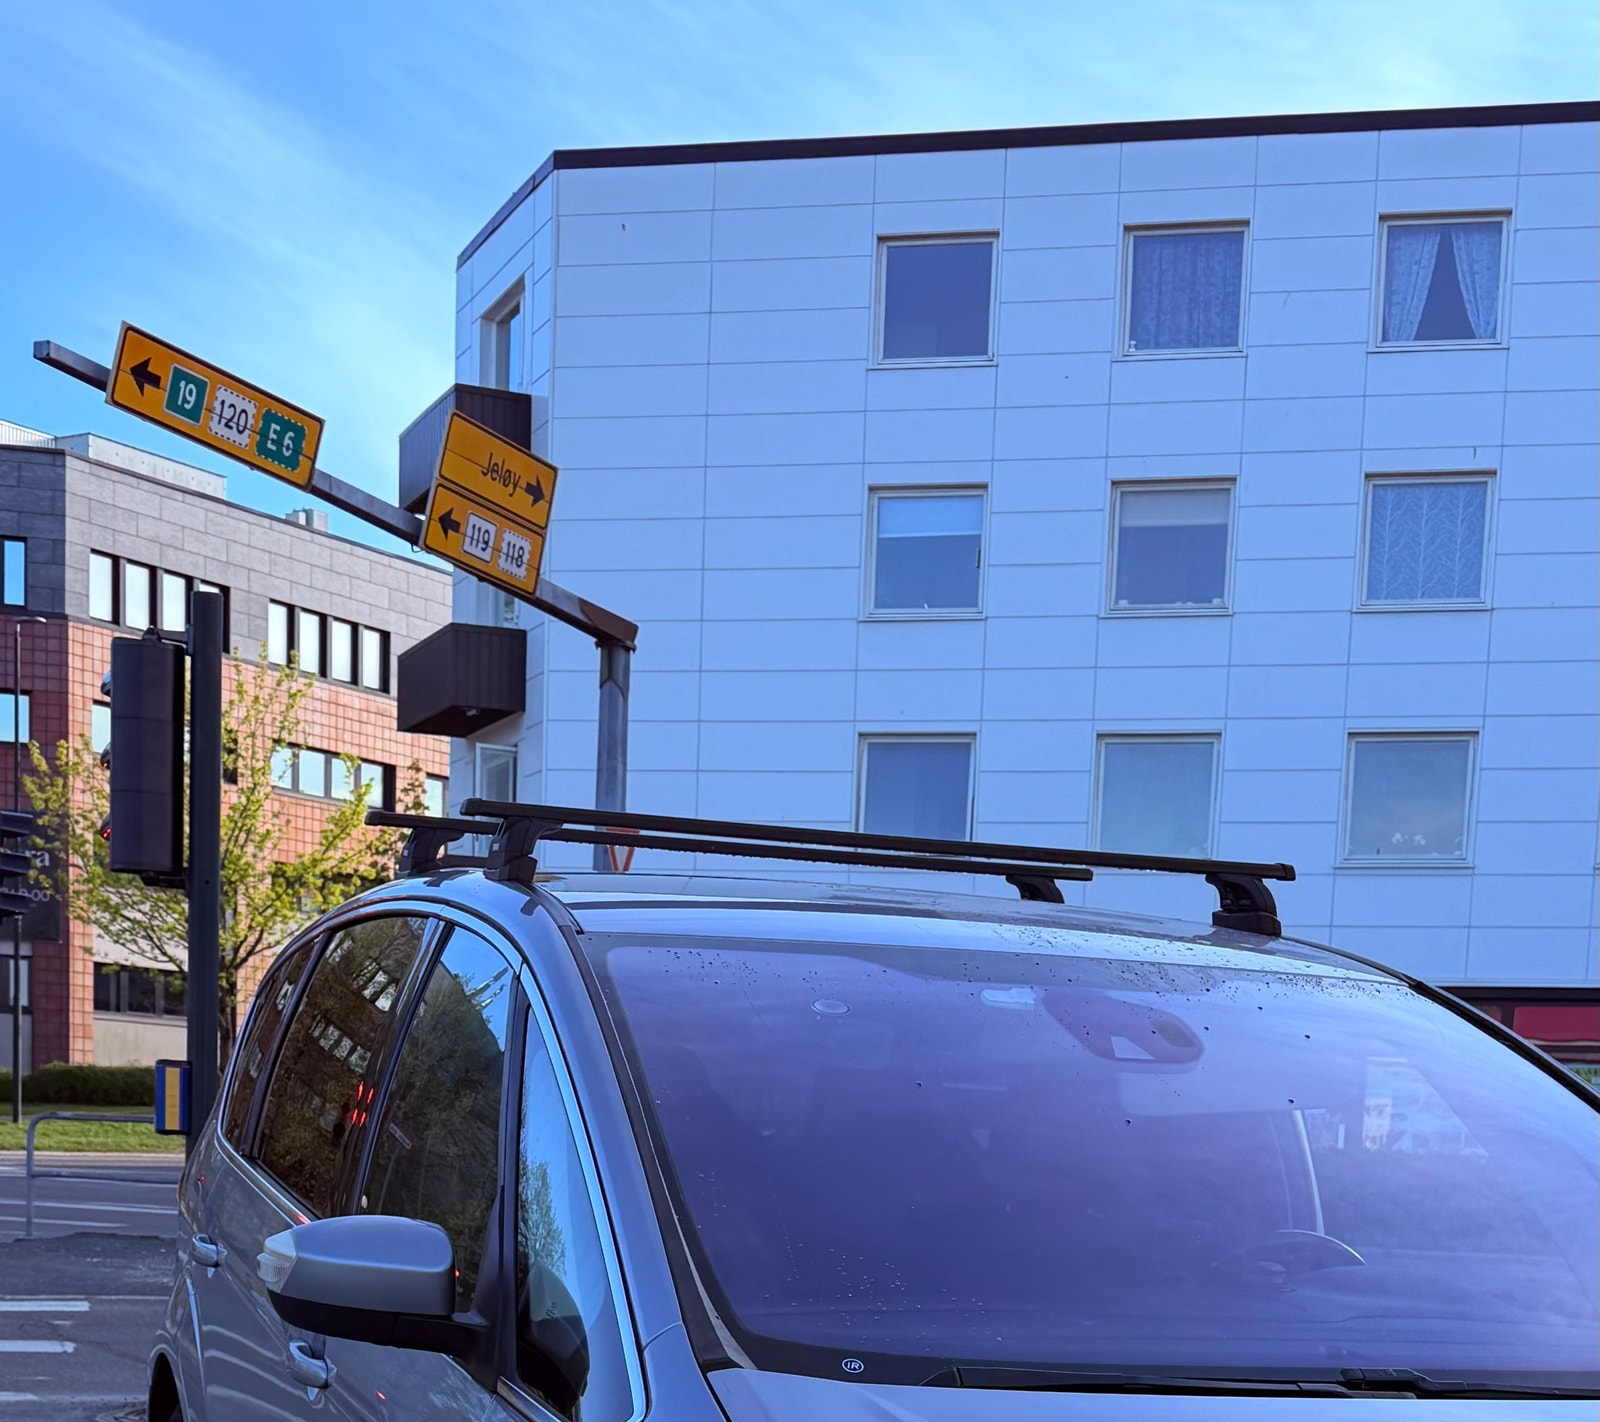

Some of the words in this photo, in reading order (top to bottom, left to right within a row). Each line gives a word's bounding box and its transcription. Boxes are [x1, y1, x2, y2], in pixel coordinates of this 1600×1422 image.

[177, 380, 197, 410] 19
[217, 399, 249, 435] 120
[481, 452, 521, 498] Jeløy
[470, 523, 491, 552] 119
[505, 540, 525, 569] 118
[847, 1361, 860, 1370] IR
